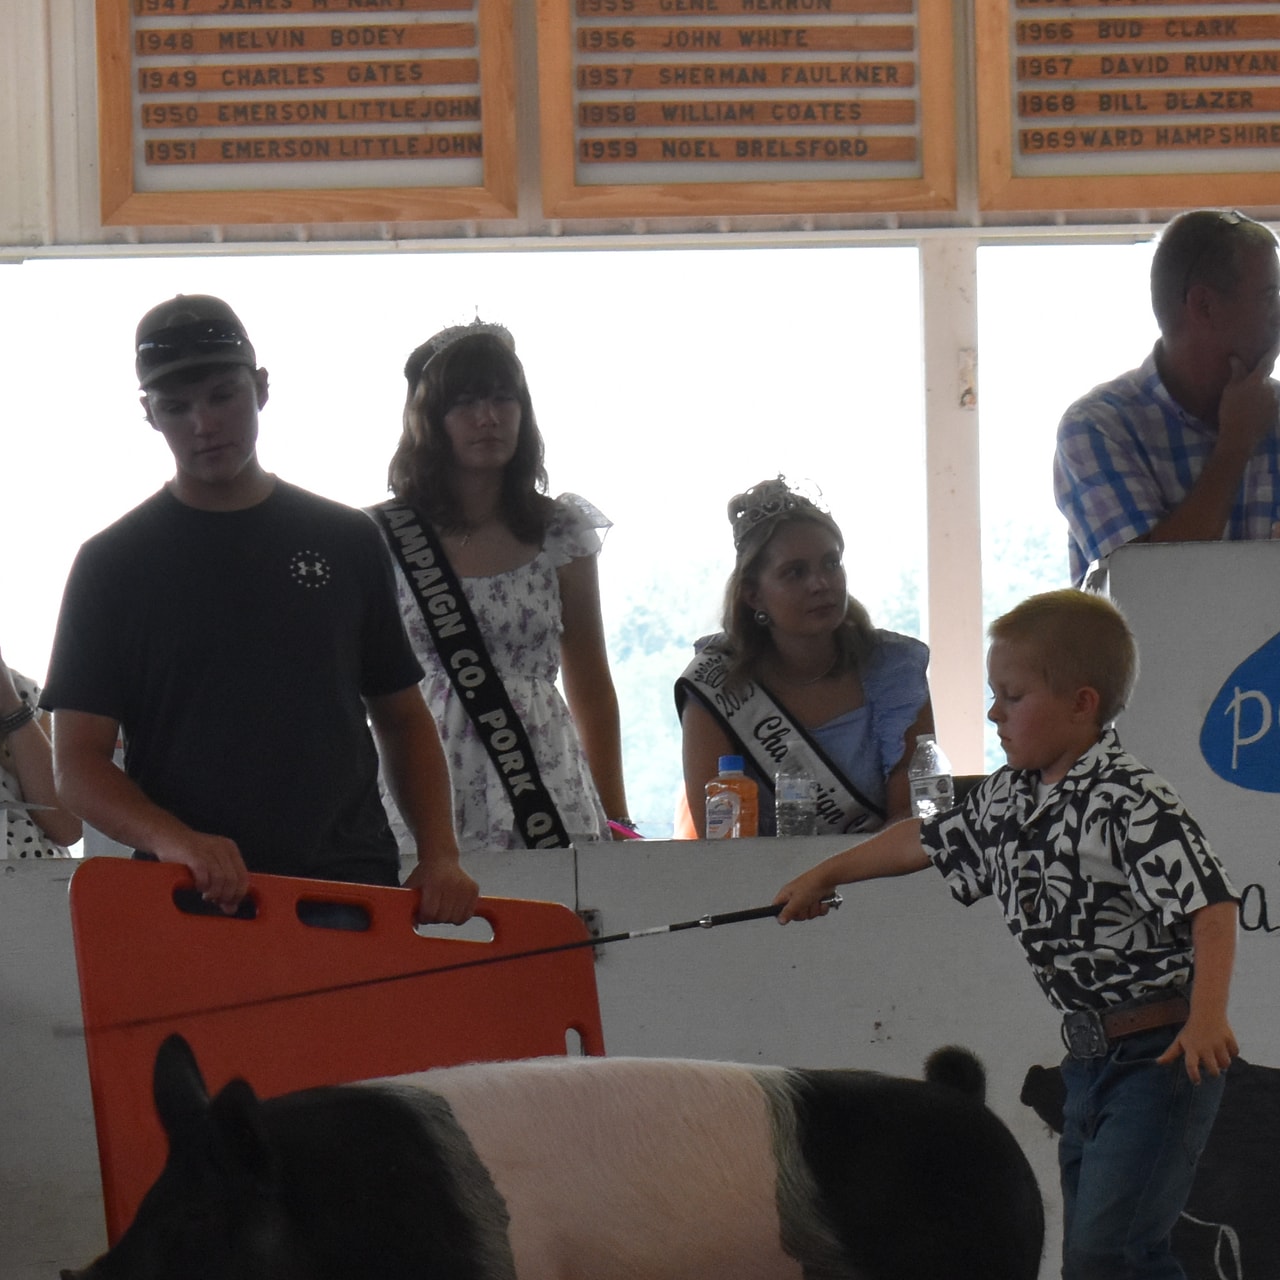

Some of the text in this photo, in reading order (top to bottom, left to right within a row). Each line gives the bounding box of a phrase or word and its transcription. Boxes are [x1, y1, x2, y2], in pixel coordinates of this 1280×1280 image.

[139, 28, 406, 50] 1948 MELVIN BODEY
[581, 29, 809, 48] 1956 JOHN WHITE
[1021, 18, 1238, 40] 1966 BUD CLARK
[581, 65, 899, 86] 1957 SHERMAN FAULKNER
[1022, 54, 1279, 76] 1967 DAVID RUNYAN
[141, 65, 423, 88] 1949 CHARLES GATES
[144, 100, 480, 123] 1950 EMERSON LITTLEJOHN
[1021, 91, 1254, 112] 1968 BILL BLAZER
[581, 103, 862, 123] 1958 WILLIAM COATES
[148, 135, 482, 161] 1951 EMERSON LITTLEJOHN
[581, 139, 868, 158] 1959 NOEL BRELSFORD
[1022, 131, 1076, 148] 1969
[1080, 129, 1143, 147] WARD
[450, 648, 485, 699] CO.
[479, 709, 537, 797] PORK
